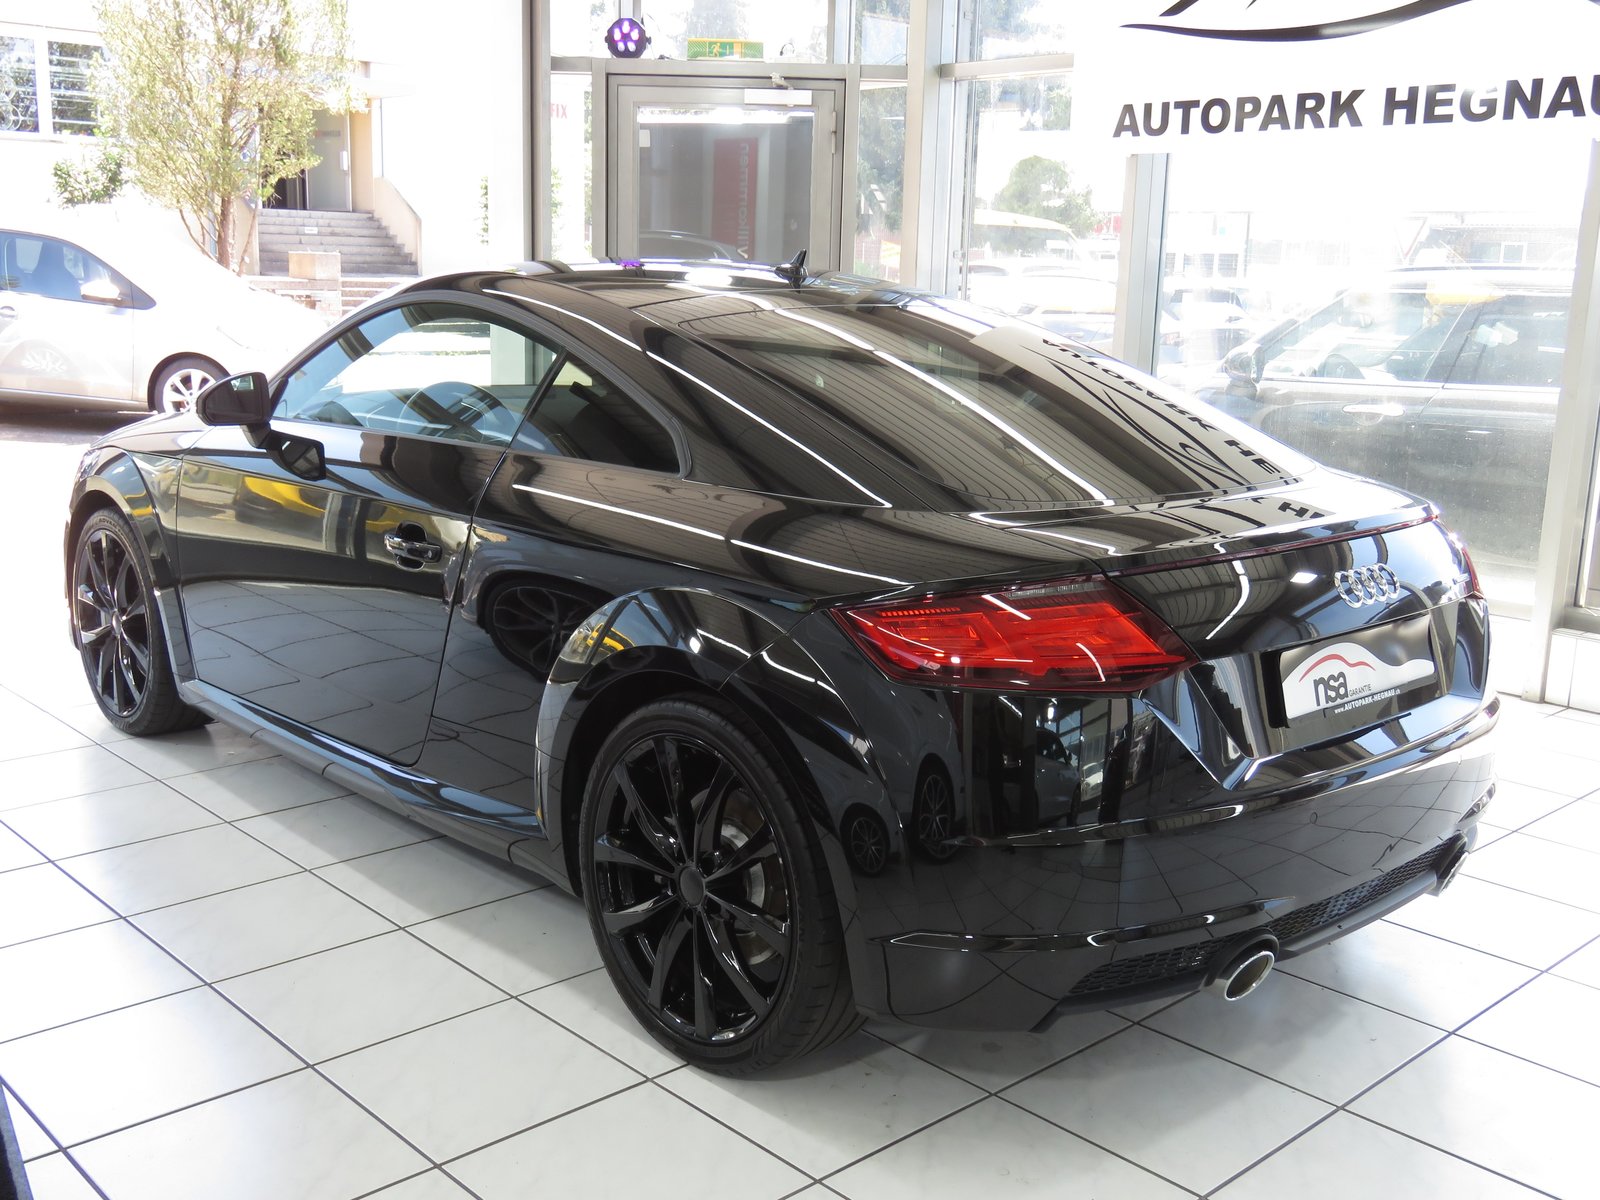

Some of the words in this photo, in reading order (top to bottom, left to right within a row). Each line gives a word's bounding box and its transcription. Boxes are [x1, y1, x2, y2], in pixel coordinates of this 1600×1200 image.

[1112, 89, 1366, 138] AUTOPARK
[1313, 671, 1349, 707] nsa
[1348, 683, 1372, 698] GARANTIE
